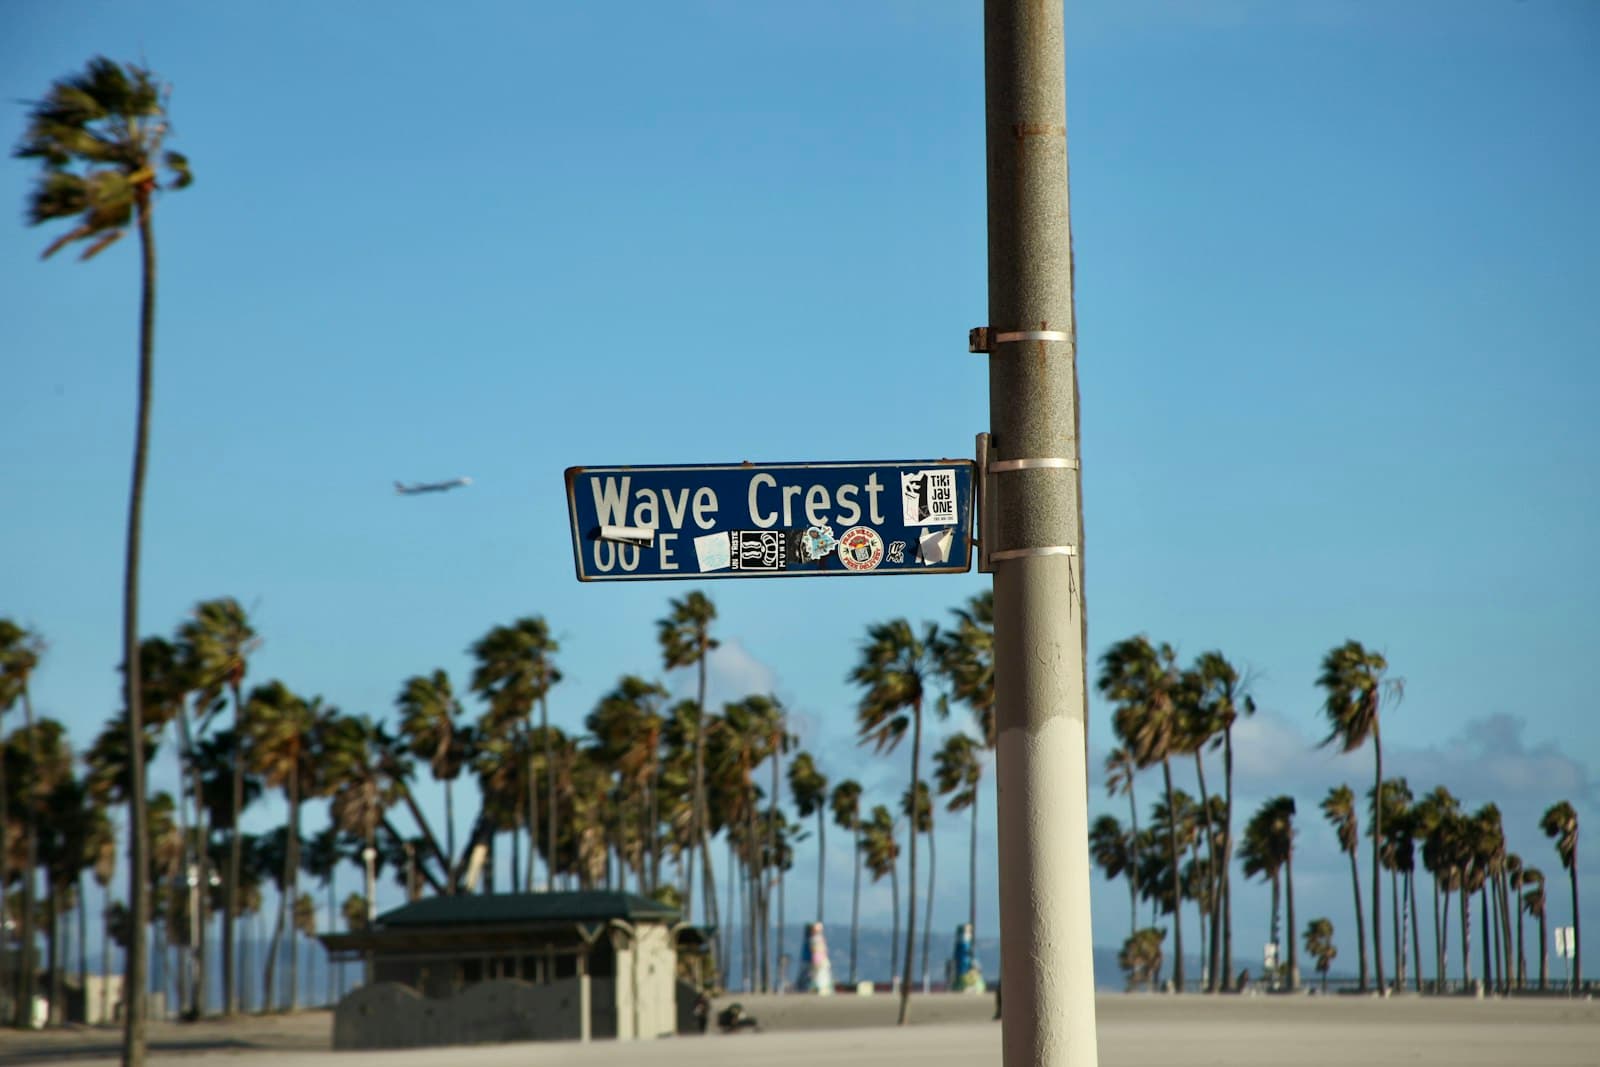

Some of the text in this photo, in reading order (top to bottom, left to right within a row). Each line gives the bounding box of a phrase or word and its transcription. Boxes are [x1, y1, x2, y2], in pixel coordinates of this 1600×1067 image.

[590, 473, 885, 530] Wave Crest
[932, 500, 953, 513] ONE
[659, 533, 679, 570] E
